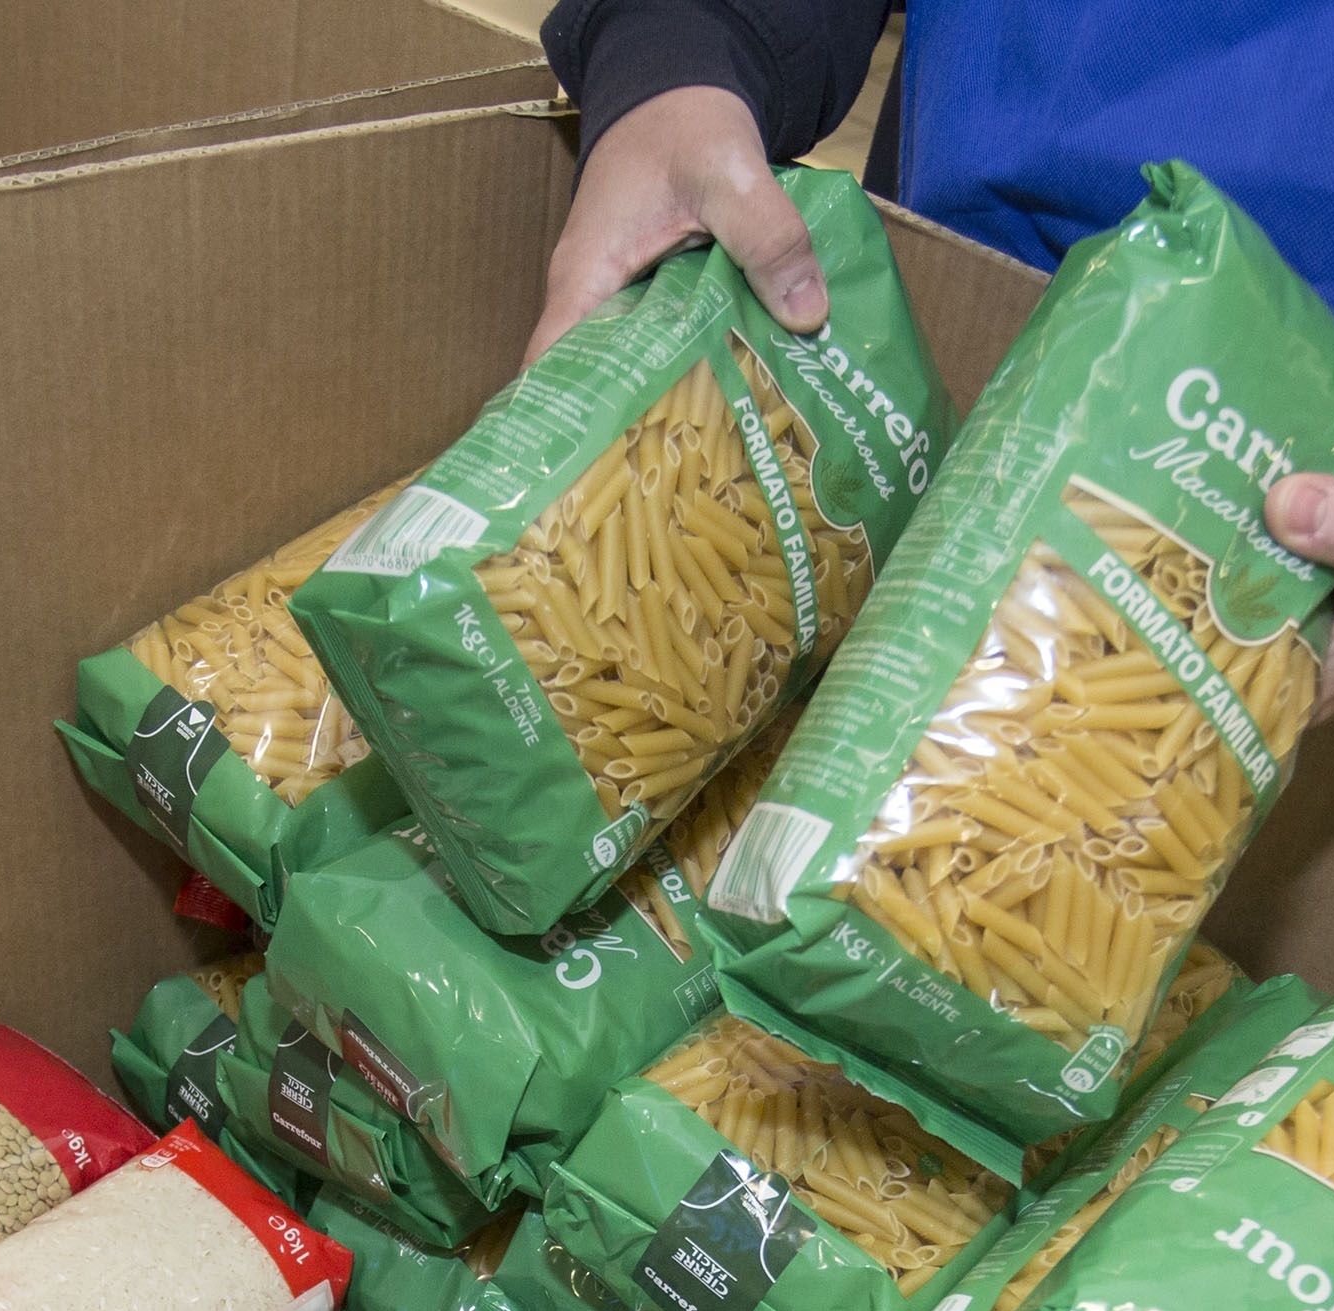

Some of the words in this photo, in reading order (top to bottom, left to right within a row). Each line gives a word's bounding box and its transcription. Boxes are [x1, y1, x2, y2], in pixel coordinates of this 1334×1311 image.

[771, 331, 890, 502] Macarrones
[795, 321, 930, 497] arrefo
[733, 395, 799, 532] FORMATO
[781, 533, 816, 658] FAMILIAR
[491, 674, 513, 698] AL
[513, 682, 531, 697] 7
[1087, 551, 1205, 683] FORMATO
[1194, 668, 1277, 793] FAMILIAR
[501, 693, 542, 747] DENTE
[519, 692, 546, 724] min
[887, 970, 913, 995] AL
[907, 983, 961, 1026] DENTE
[924, 977, 956, 1005] min
[345, 1027, 413, 1095] Carrefour
[176, 1084, 210, 1120] CIERRE
[277, 1082, 314, 1109] CIERRE
[269, 1111, 323, 1150] Carrefour
[672, 1247, 731, 1298] CIERRE
[686, 1245, 728, 1282] FÁCIL
